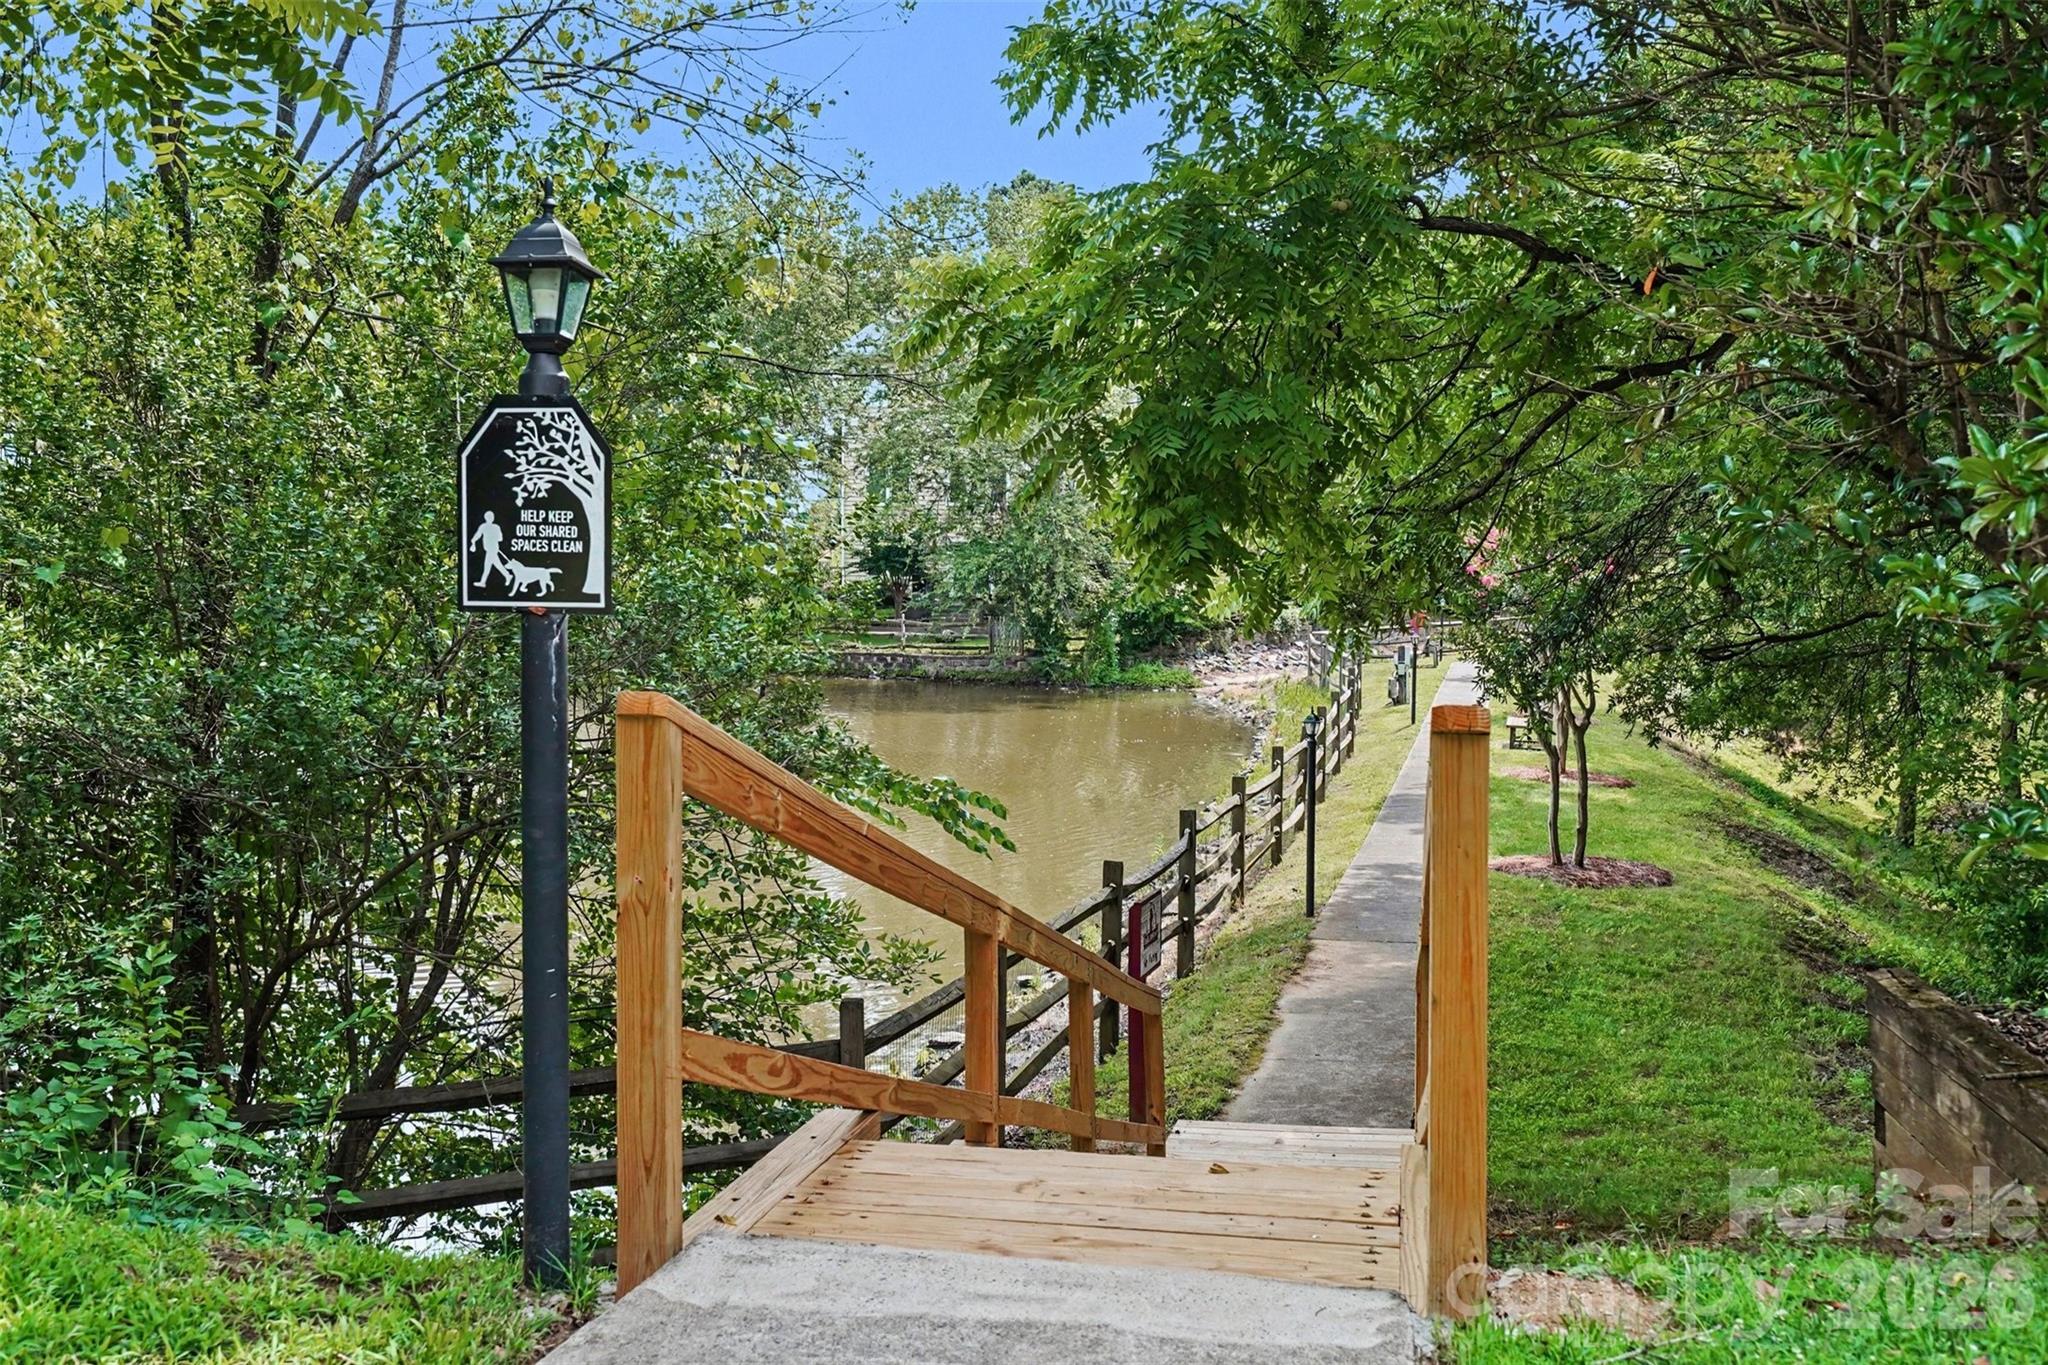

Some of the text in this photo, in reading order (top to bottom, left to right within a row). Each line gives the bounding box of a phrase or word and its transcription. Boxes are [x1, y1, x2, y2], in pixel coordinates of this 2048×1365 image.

[520, 509, 574, 523] HELP KEEP
[515, 523, 578, 538] OUR SHARED
[510, 538, 583, 553] SPACES CLEAN
